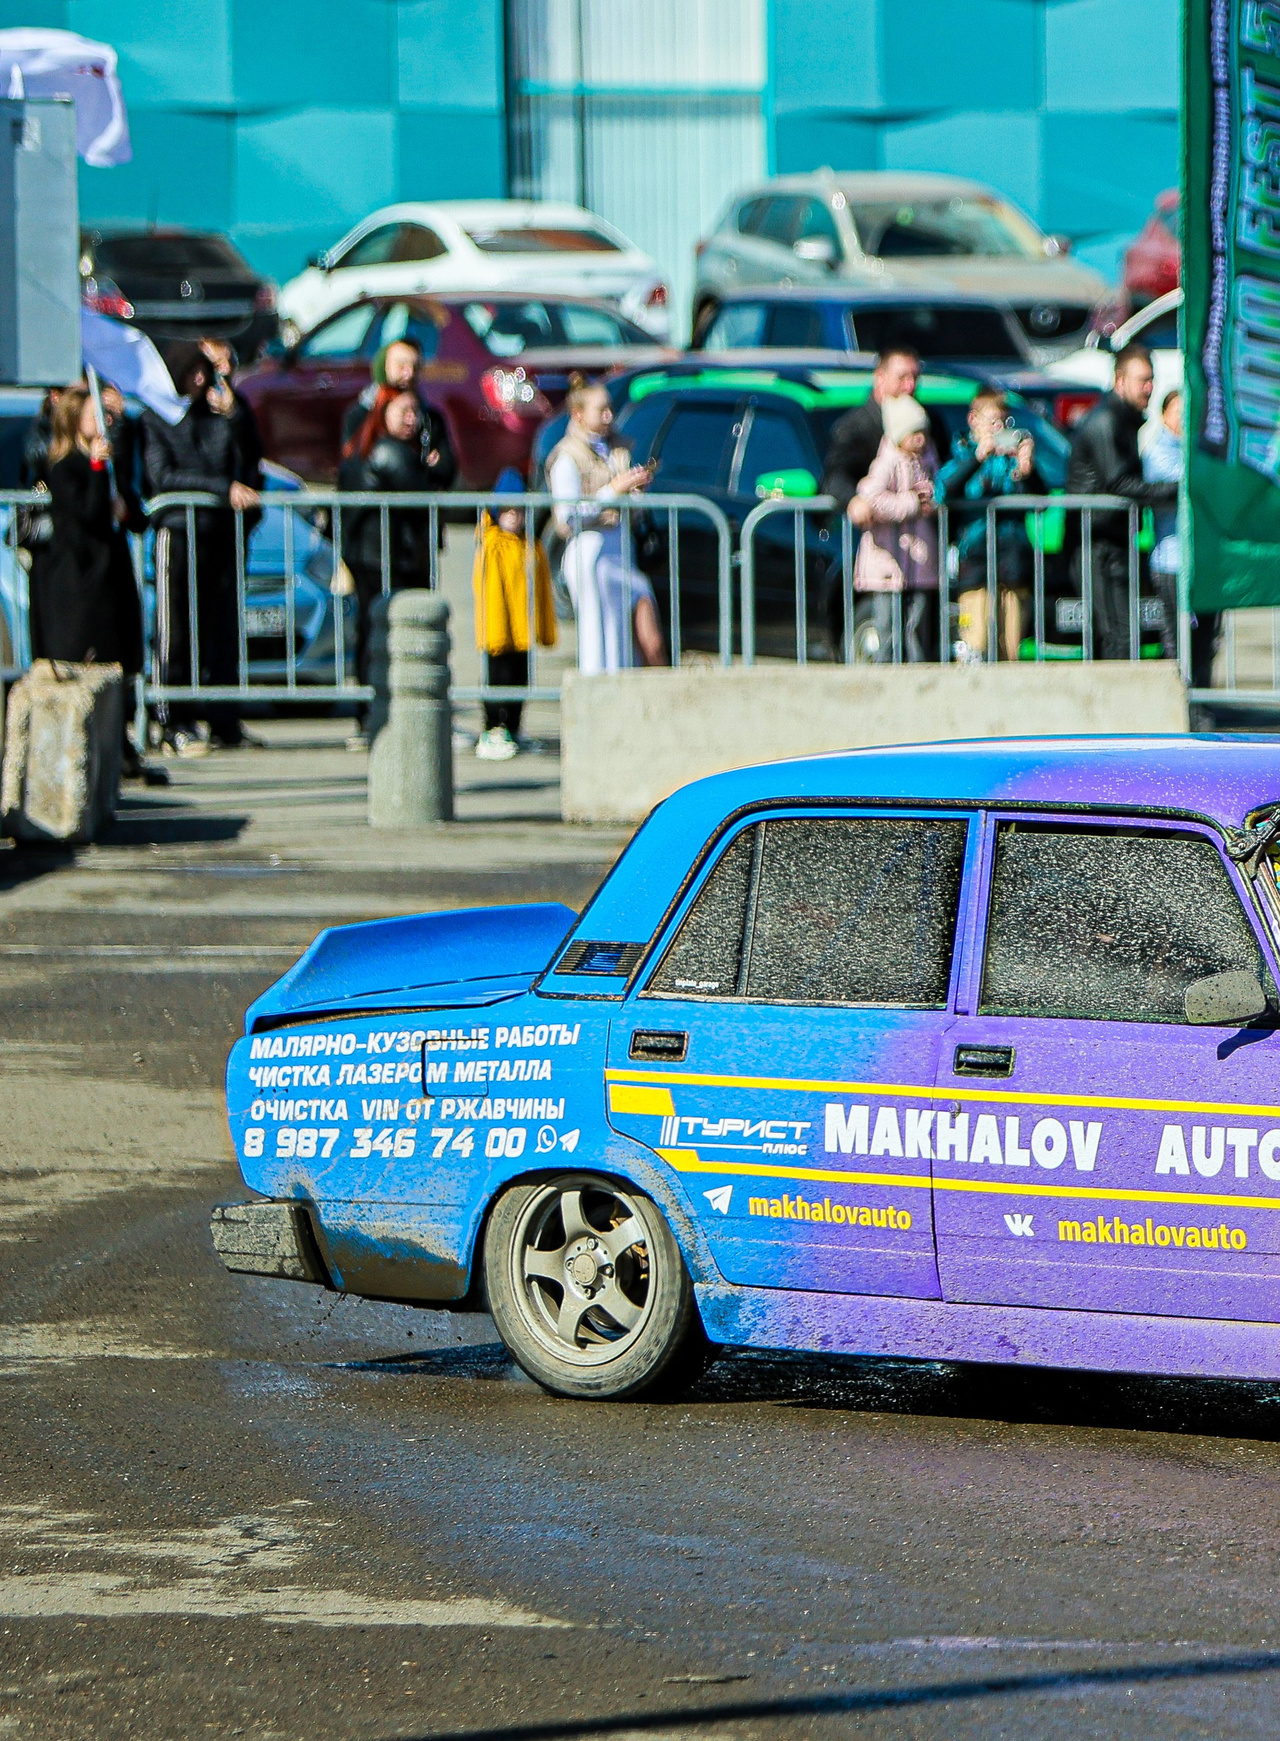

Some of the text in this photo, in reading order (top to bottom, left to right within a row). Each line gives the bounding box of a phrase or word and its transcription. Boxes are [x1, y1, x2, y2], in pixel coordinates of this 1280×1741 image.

[250, 1024, 581, 1059] МАЛЯРНО-КУЗОВНЫЕ РАБОТЫ
[248, 1059, 551, 1088] ЧИСТКА ЛАЗЕРОМ МЕТАЛЛА
[250, 1098, 565, 1121] ОЧИСТКА VIN ОТ РЖАВЧИНЫ
[243, 1127, 527, 1158] 8 987 346 74 00
[680, 1116, 812, 1140] ТУРИСТ
[824, 1103, 1103, 1171] MAKHALOV
[761, 1143, 808, 1156] ПЛЮС
[748, 1193, 912, 1230] makhalovauto
[1058, 1215, 1247, 1250] makhalovauto
